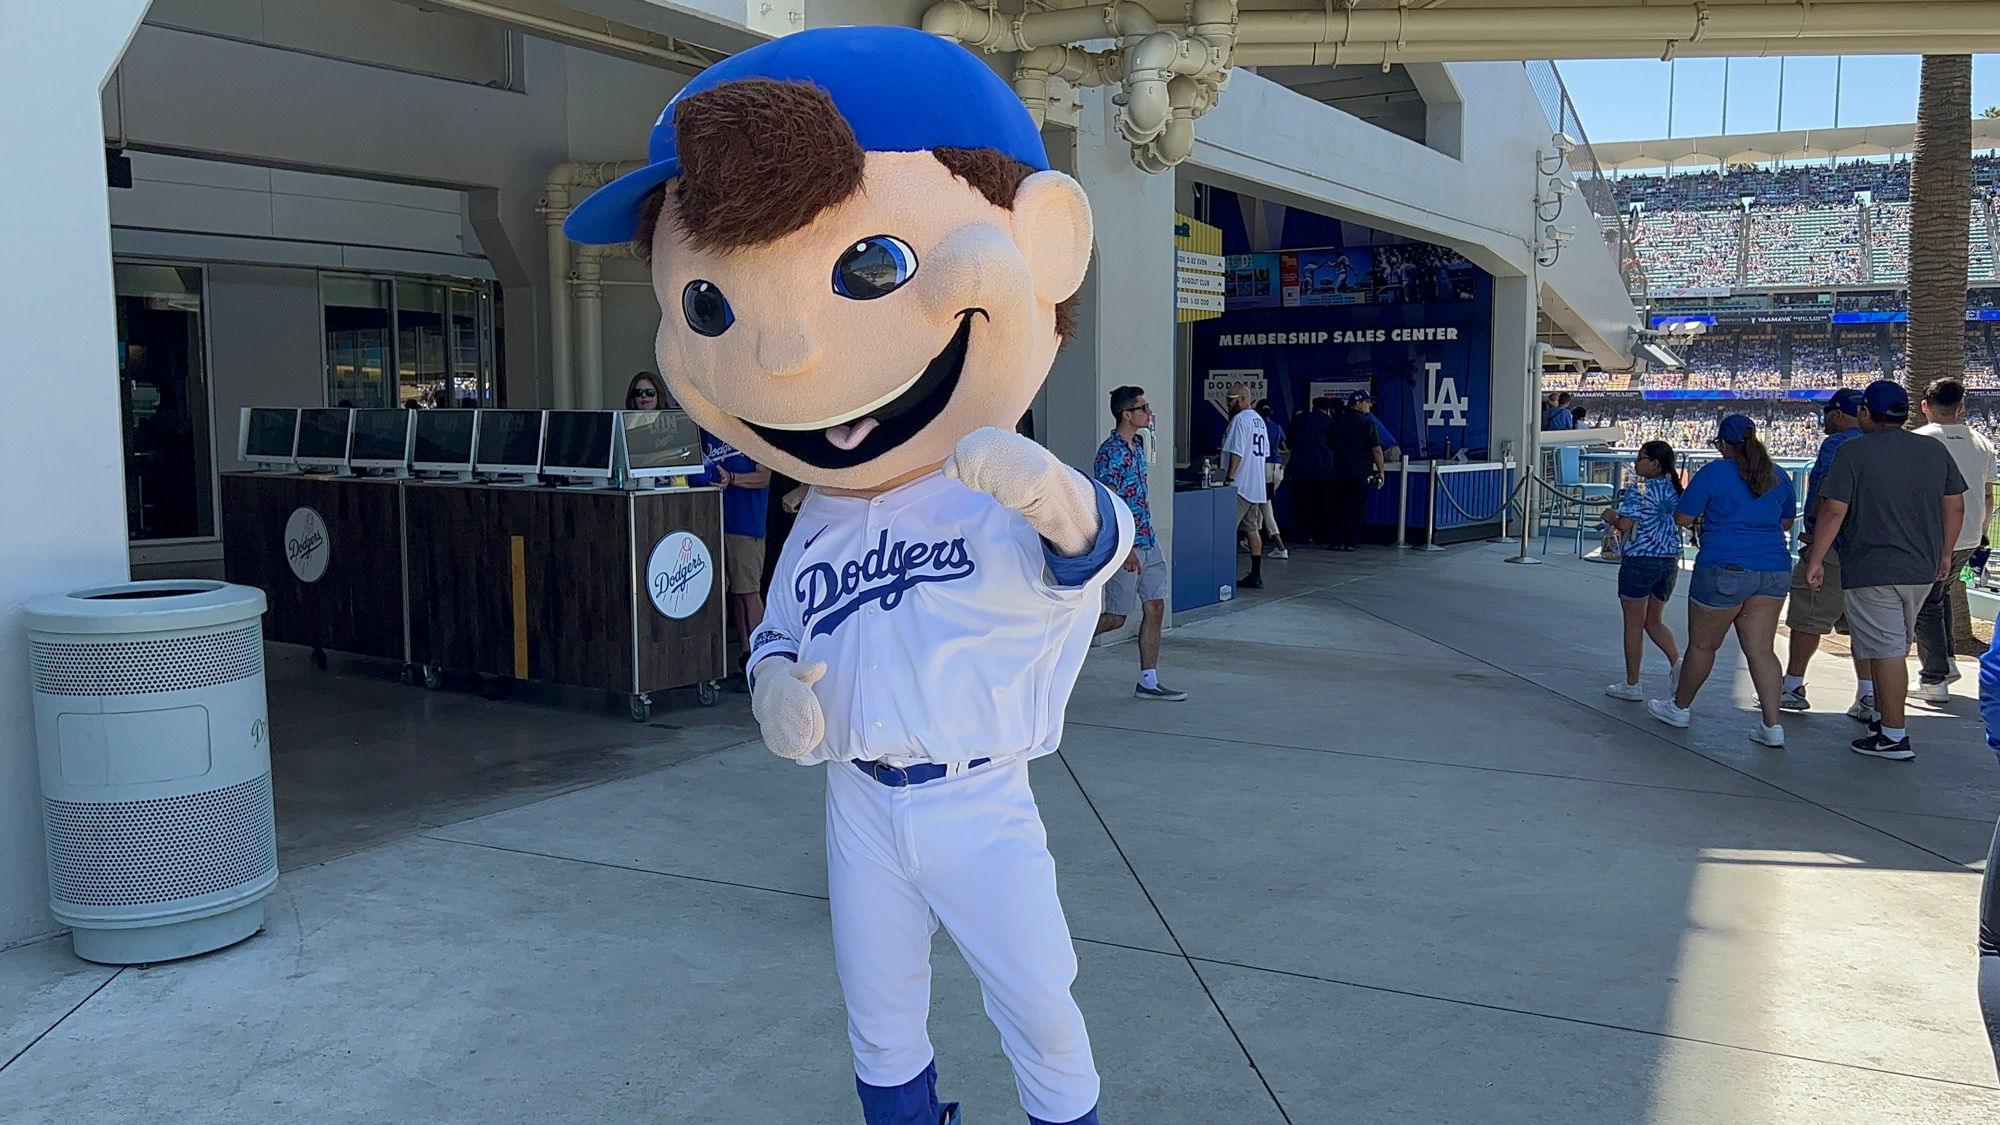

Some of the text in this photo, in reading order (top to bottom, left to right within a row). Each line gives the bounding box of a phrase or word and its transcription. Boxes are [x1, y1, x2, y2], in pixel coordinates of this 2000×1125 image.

[1197, 258, 1208, 266] EVEN
[1219, 327, 1458, 347] MEMBERSHIP SALES CENTER
[1423, 362, 1469, 426] LA
[1252, 433, 1265, 457] 50
[288, 530, 324, 560] Dodgers
[655, 554, 706, 598] Dodgers
[795, 528, 975, 640] Dodgers
